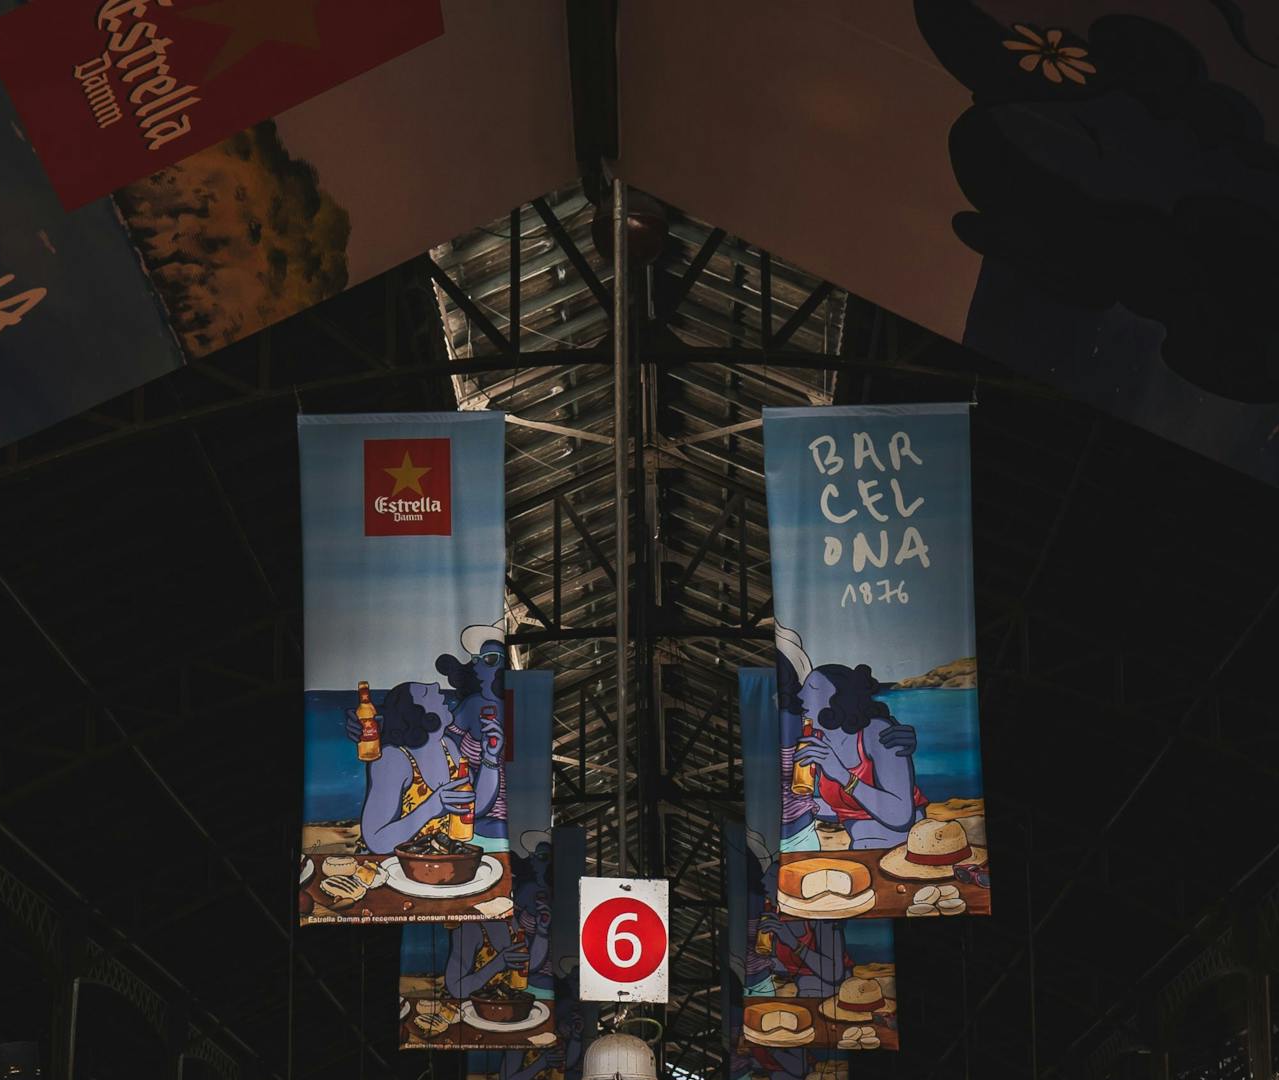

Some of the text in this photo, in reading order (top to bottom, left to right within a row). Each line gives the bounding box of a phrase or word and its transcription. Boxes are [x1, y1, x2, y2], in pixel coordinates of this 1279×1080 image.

[72, 55, 123, 129] Damm
[808, 431, 924, 474] BAR
[375, 496, 442, 514] Estrella
[394, 512, 424, 523] Damm
[820, 478, 924, 525] CEL
[823, 527, 931, 572] ONA
[841, 580, 909, 607] 1876
[337, 915, 360, 923] Damm
[606, 912, 642, 968] 6
